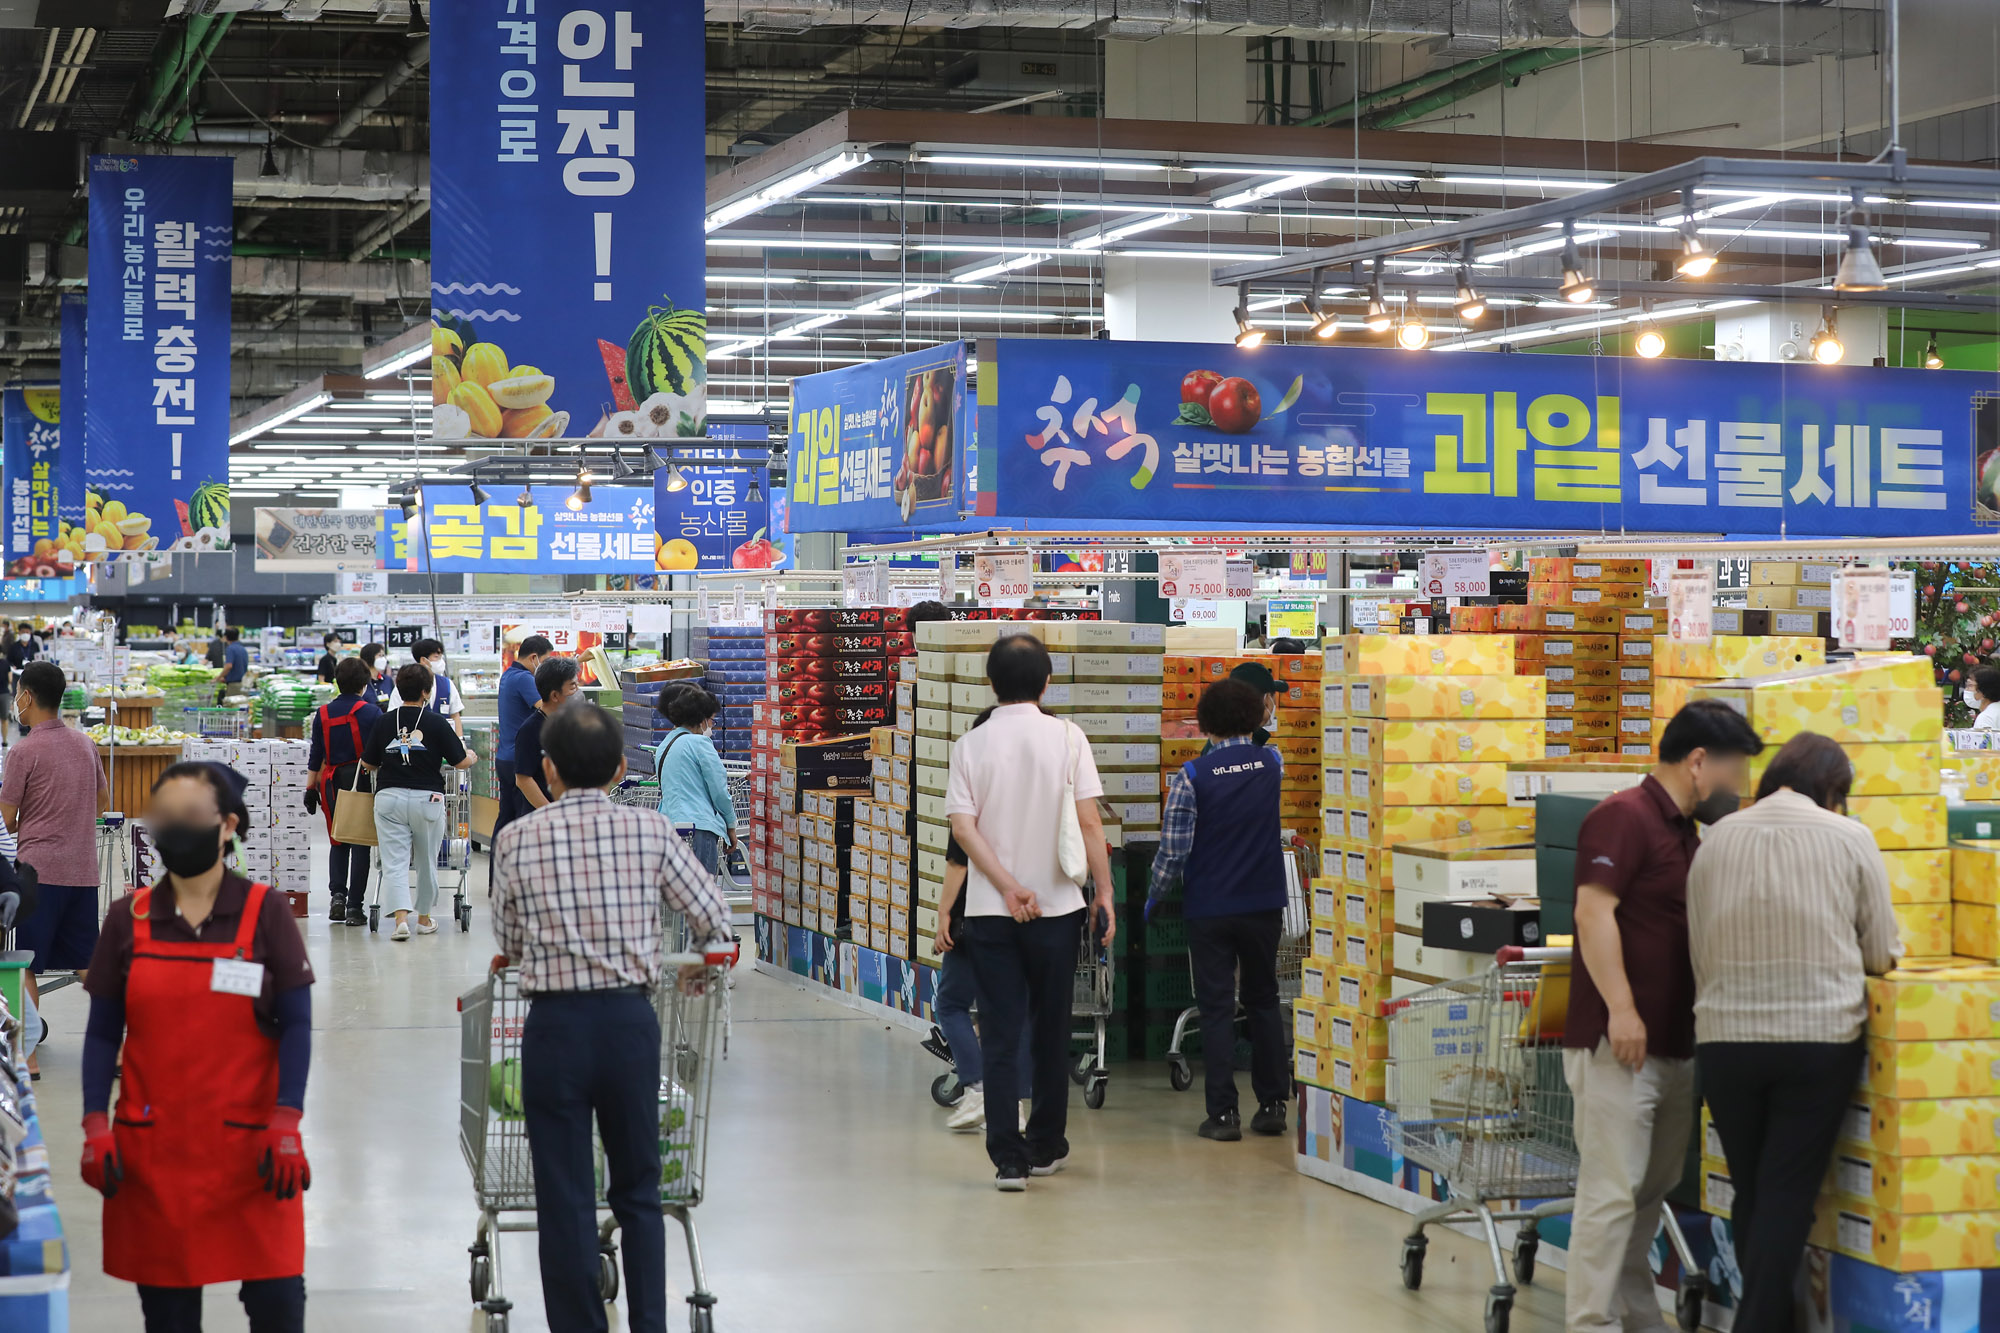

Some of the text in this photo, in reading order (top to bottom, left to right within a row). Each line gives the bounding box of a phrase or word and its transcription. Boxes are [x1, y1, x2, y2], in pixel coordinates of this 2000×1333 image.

[152, 220, 200, 480] 활력충전!
[879, 378, 899, 440] 추석
[1025, 374, 1161, 491] 추석
[793, 404, 841, 506] 과일
[1172, 443, 1411, 479] 살맛나는 농협선물
[1423, 391, 1947, 510] 과일 선물세트
[840, 445, 892, 502] 선물세트
[691, 479, 736, 506] 인증
[554, 511, 624, 523] 살맛나는 농협선물
[680, 511, 748, 537] 농산물
[294, 534, 347, 554] 건강한
[430, 504, 543, 561] 곶감
[549, 532, 655, 561] 선물세트
[1000, 583, 1028, 596] 90,000
[1108, 590, 1121, 603] Fruits
[1189, 583, 1222, 595] 75,000
[1226, 587, 1252, 598] 8,000
[1454, 581, 1486, 593] 58,000
[1192, 610, 1216, 620] 69,000
[1893, 1273, 1932, 1331] 추석
